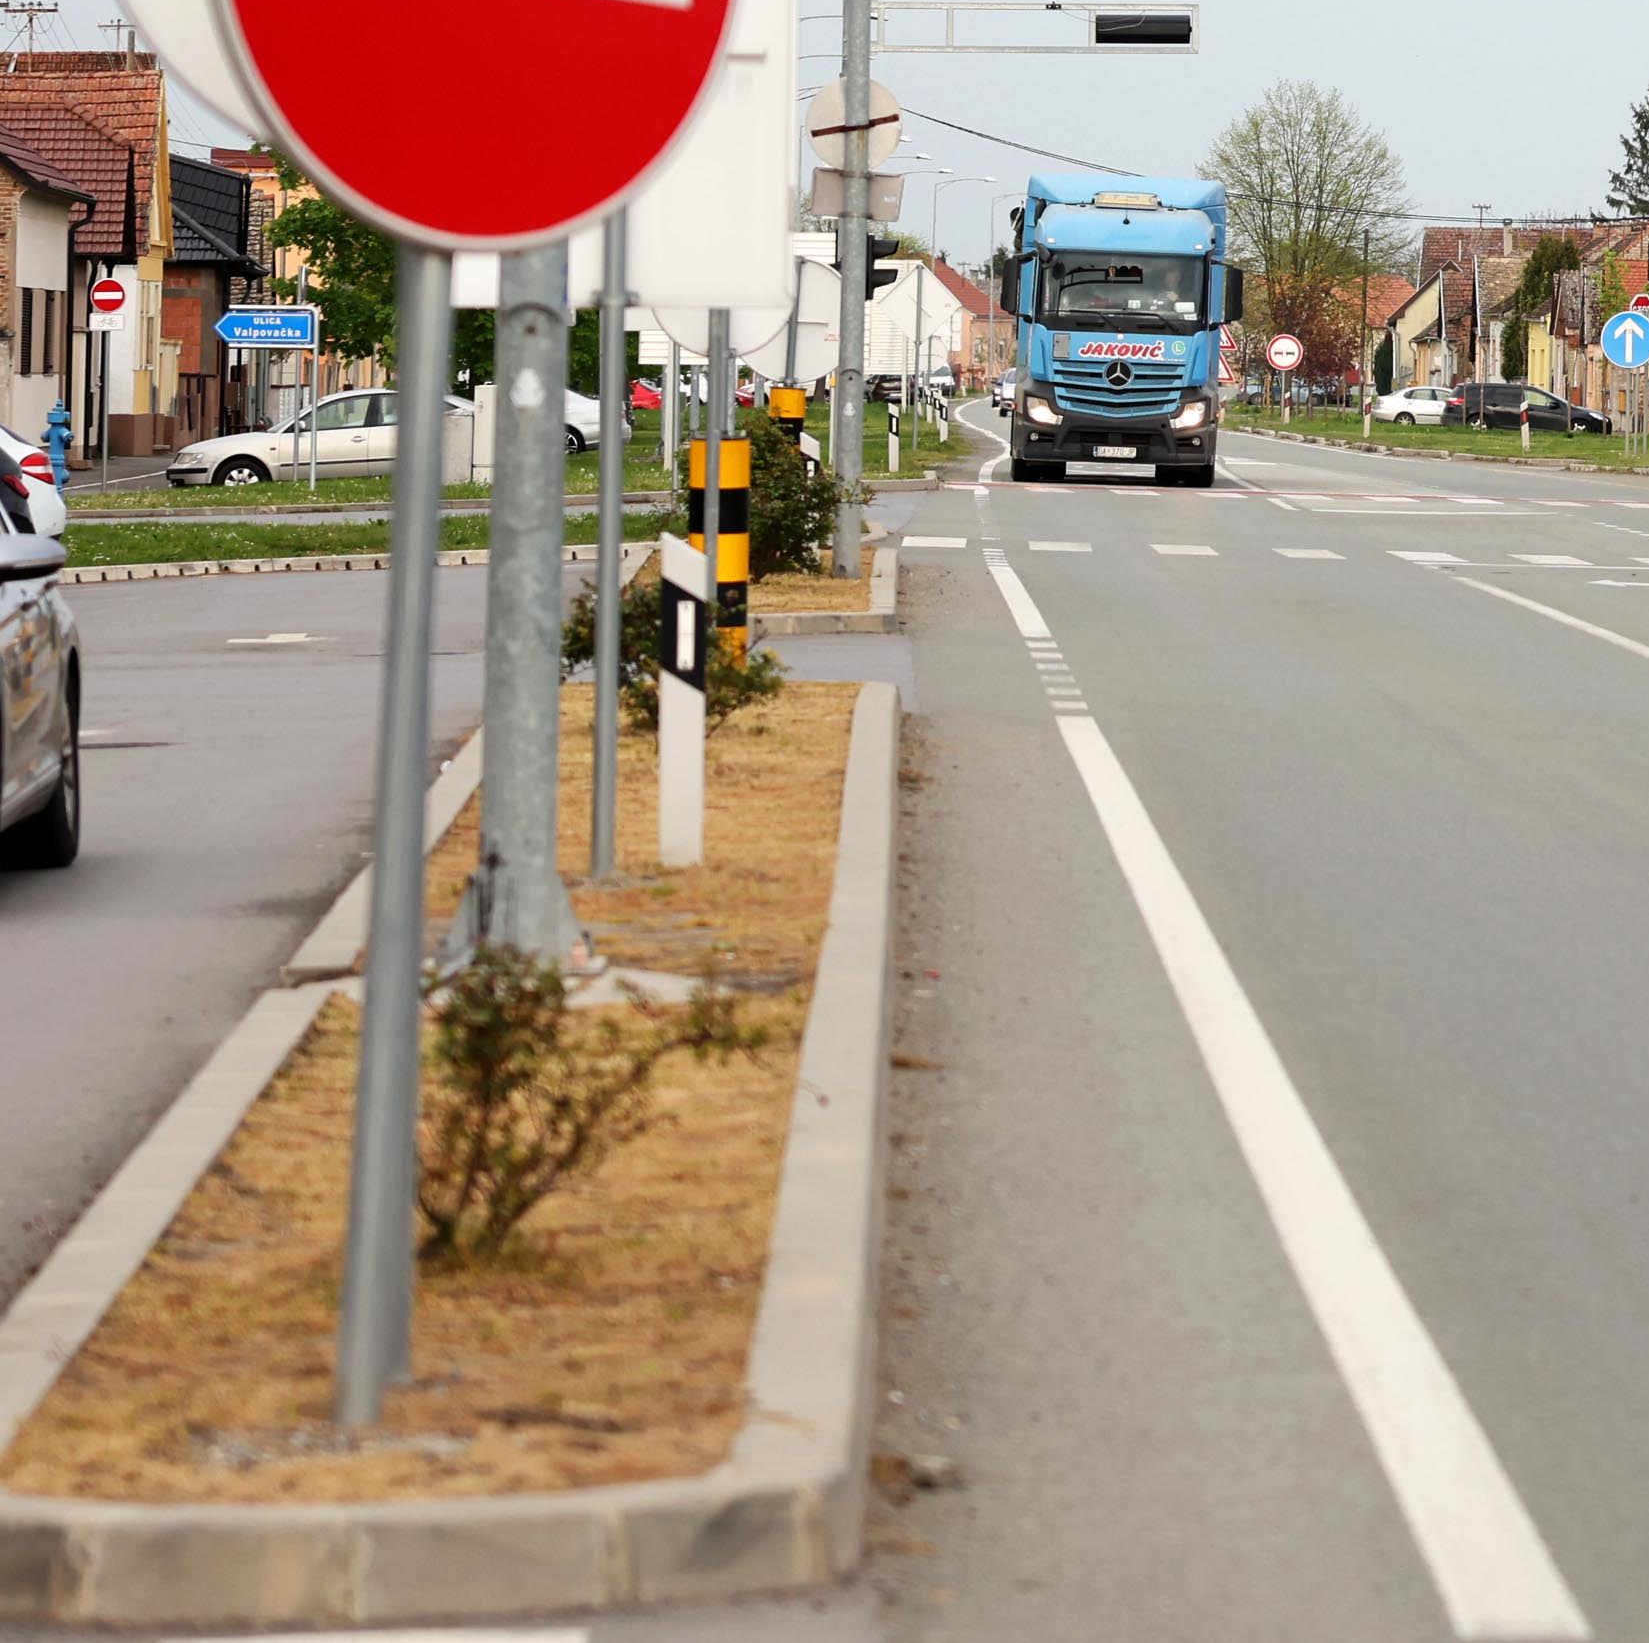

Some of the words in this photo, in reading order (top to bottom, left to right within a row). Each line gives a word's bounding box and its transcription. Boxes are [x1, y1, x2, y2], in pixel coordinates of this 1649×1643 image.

[252, 317, 282, 325] ULICA
[233, 327, 302, 338] Valpovačka
[1079, 340, 1165, 359] JAKOVIĆ
